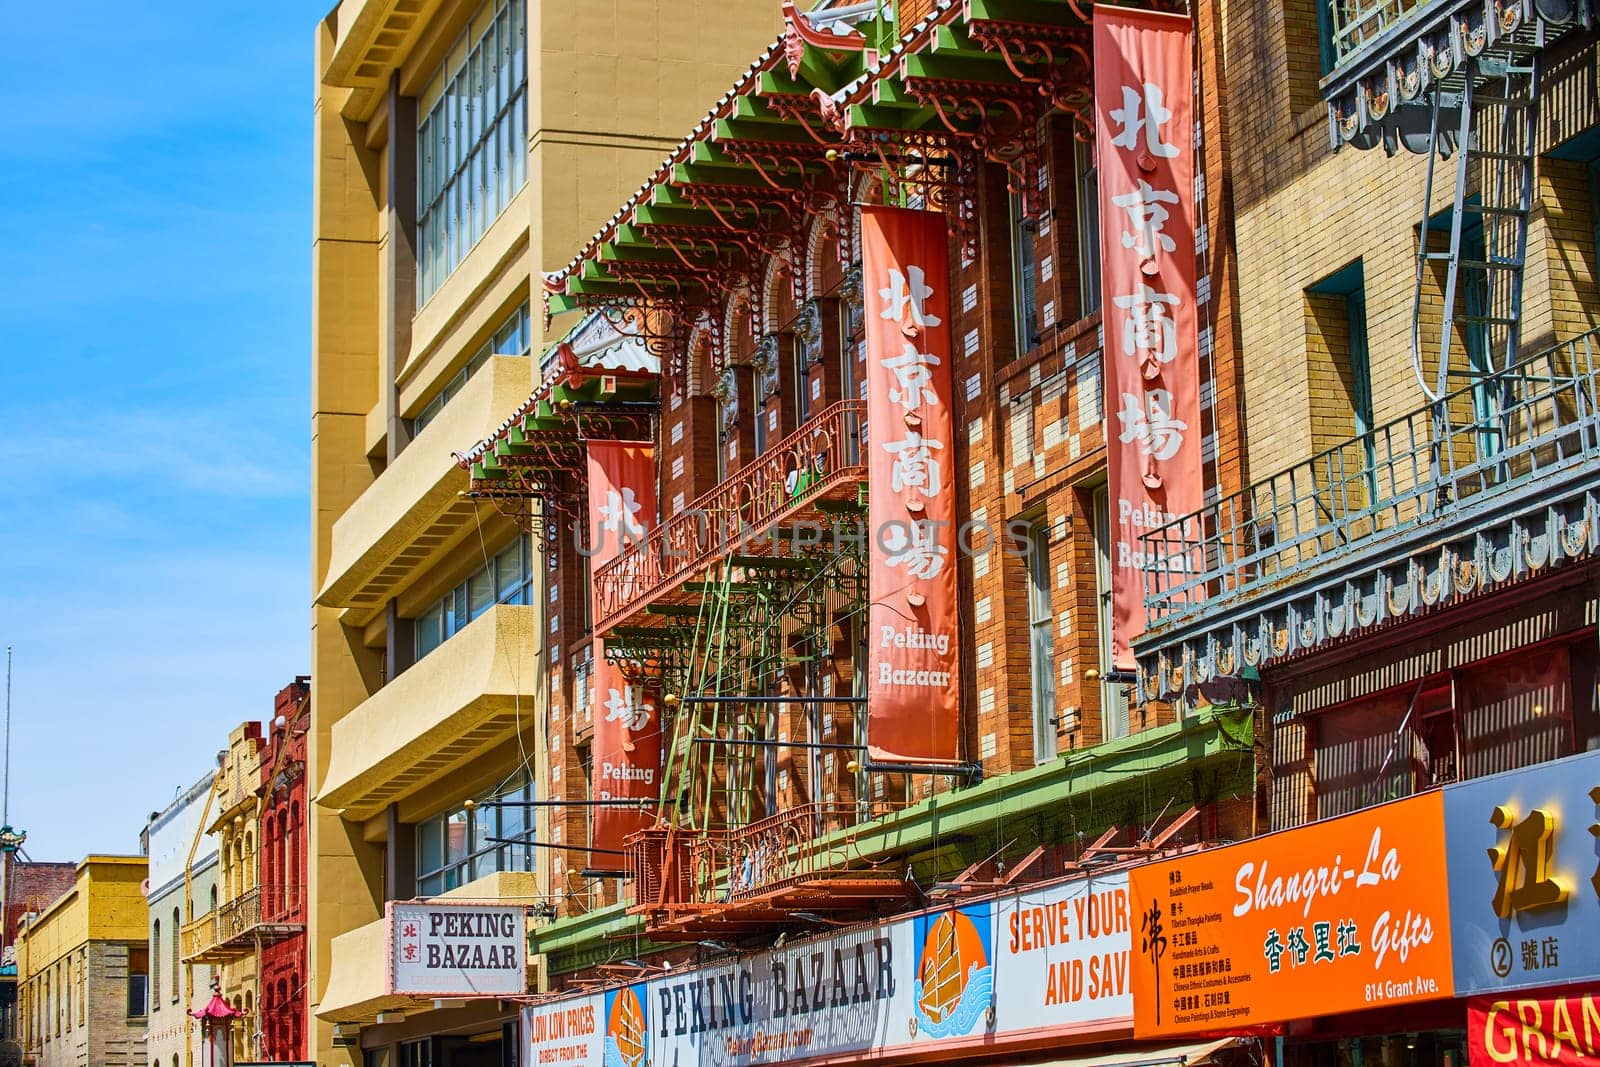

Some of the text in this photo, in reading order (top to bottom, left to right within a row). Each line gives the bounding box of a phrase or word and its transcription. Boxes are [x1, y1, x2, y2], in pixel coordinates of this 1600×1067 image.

[1109, 82, 1188, 461] 北京商場
[878, 265, 949, 580] 北京商場
[880, 626, 949, 656] Peking
[878, 662, 950, 686] Bazaar
[602, 762, 654, 784] Peking
[1233, 825, 1402, 919] Shangri-La
[429, 912, 515, 938] PEKING
[1010, 889, 1127, 954] SERVE YOUR
[1371, 909, 1434, 970] Gifts
[403, 923, 418, 960] 北京
[426, 944, 518, 969] BAZAAR
[1264, 918, 1361, 974] 香格里拉
[659, 937, 896, 1038] PEKING BAZAAR
[1045, 950, 1132, 1006] AND SAV
[1365, 976, 1439, 1002] 814 Grant Ave.
[531, 1005, 595, 1043] LOW LOW PRICES
[539, 1044, 587, 1064] DIRECT FROM THE
